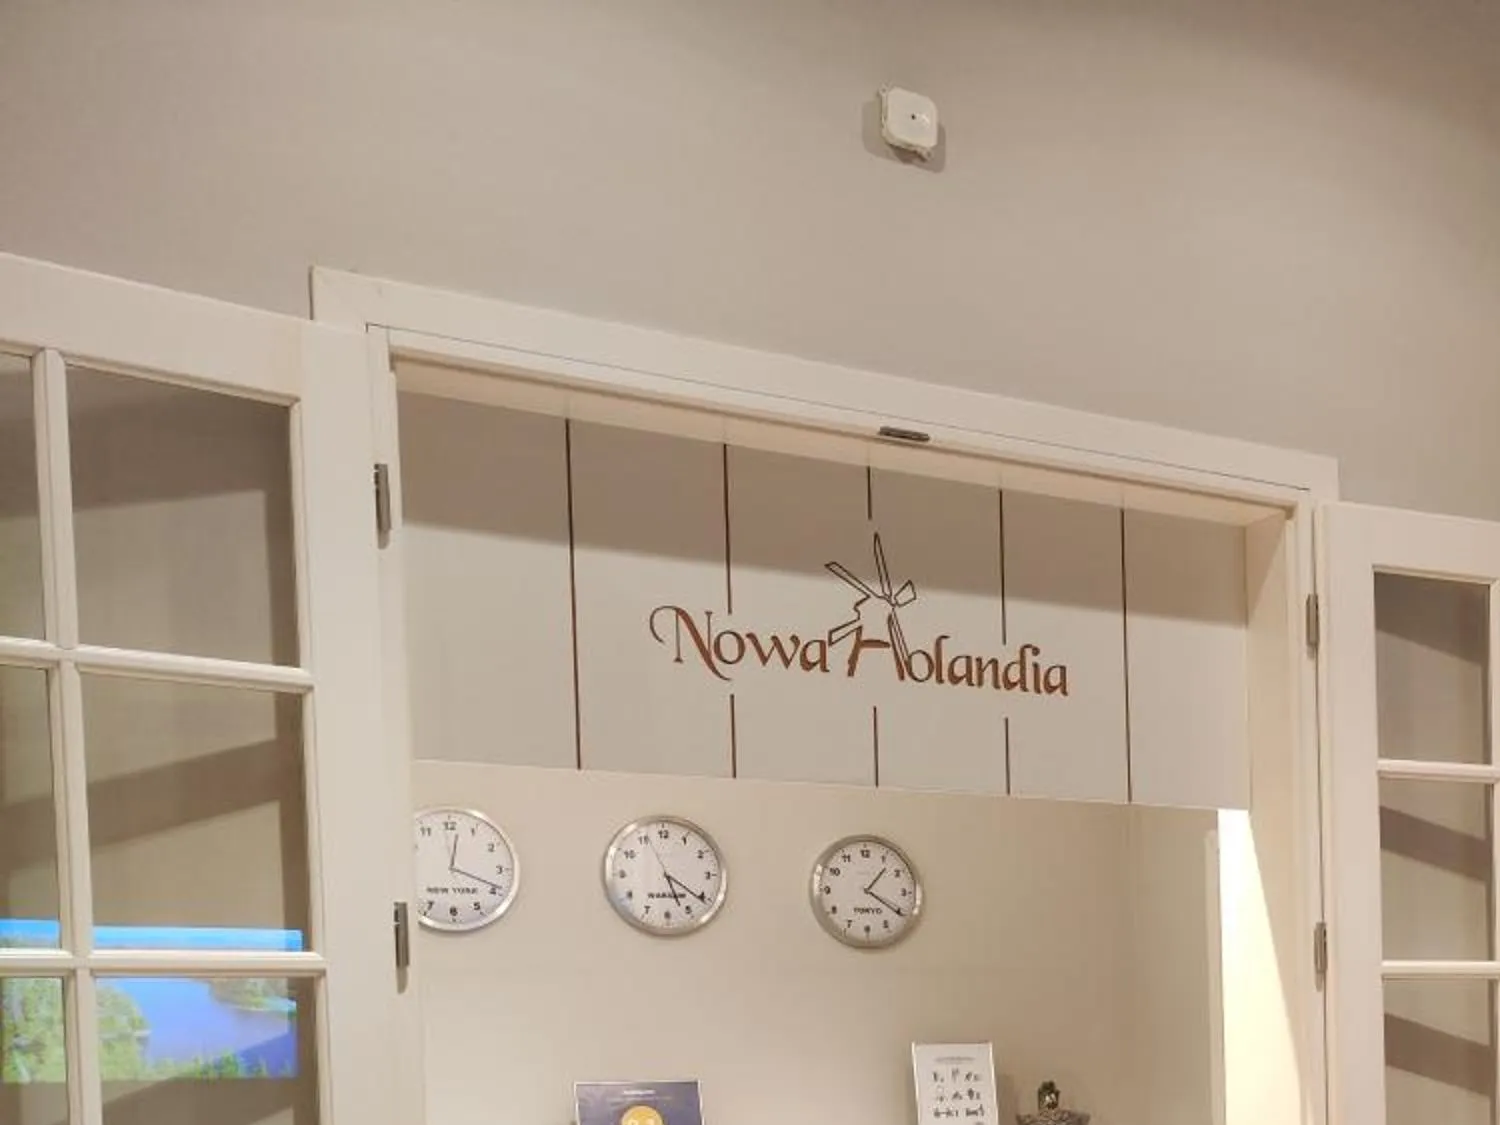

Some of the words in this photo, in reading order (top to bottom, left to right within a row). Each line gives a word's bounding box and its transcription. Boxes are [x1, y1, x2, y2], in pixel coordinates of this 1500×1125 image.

[649, 604, 830, 682] Nowa
[846, 608, 1070, 697] Holandia
[860, 849, 871, 859] 12
[829, 867, 841, 877] 10
[853, 906, 883, 915] TOKYO
